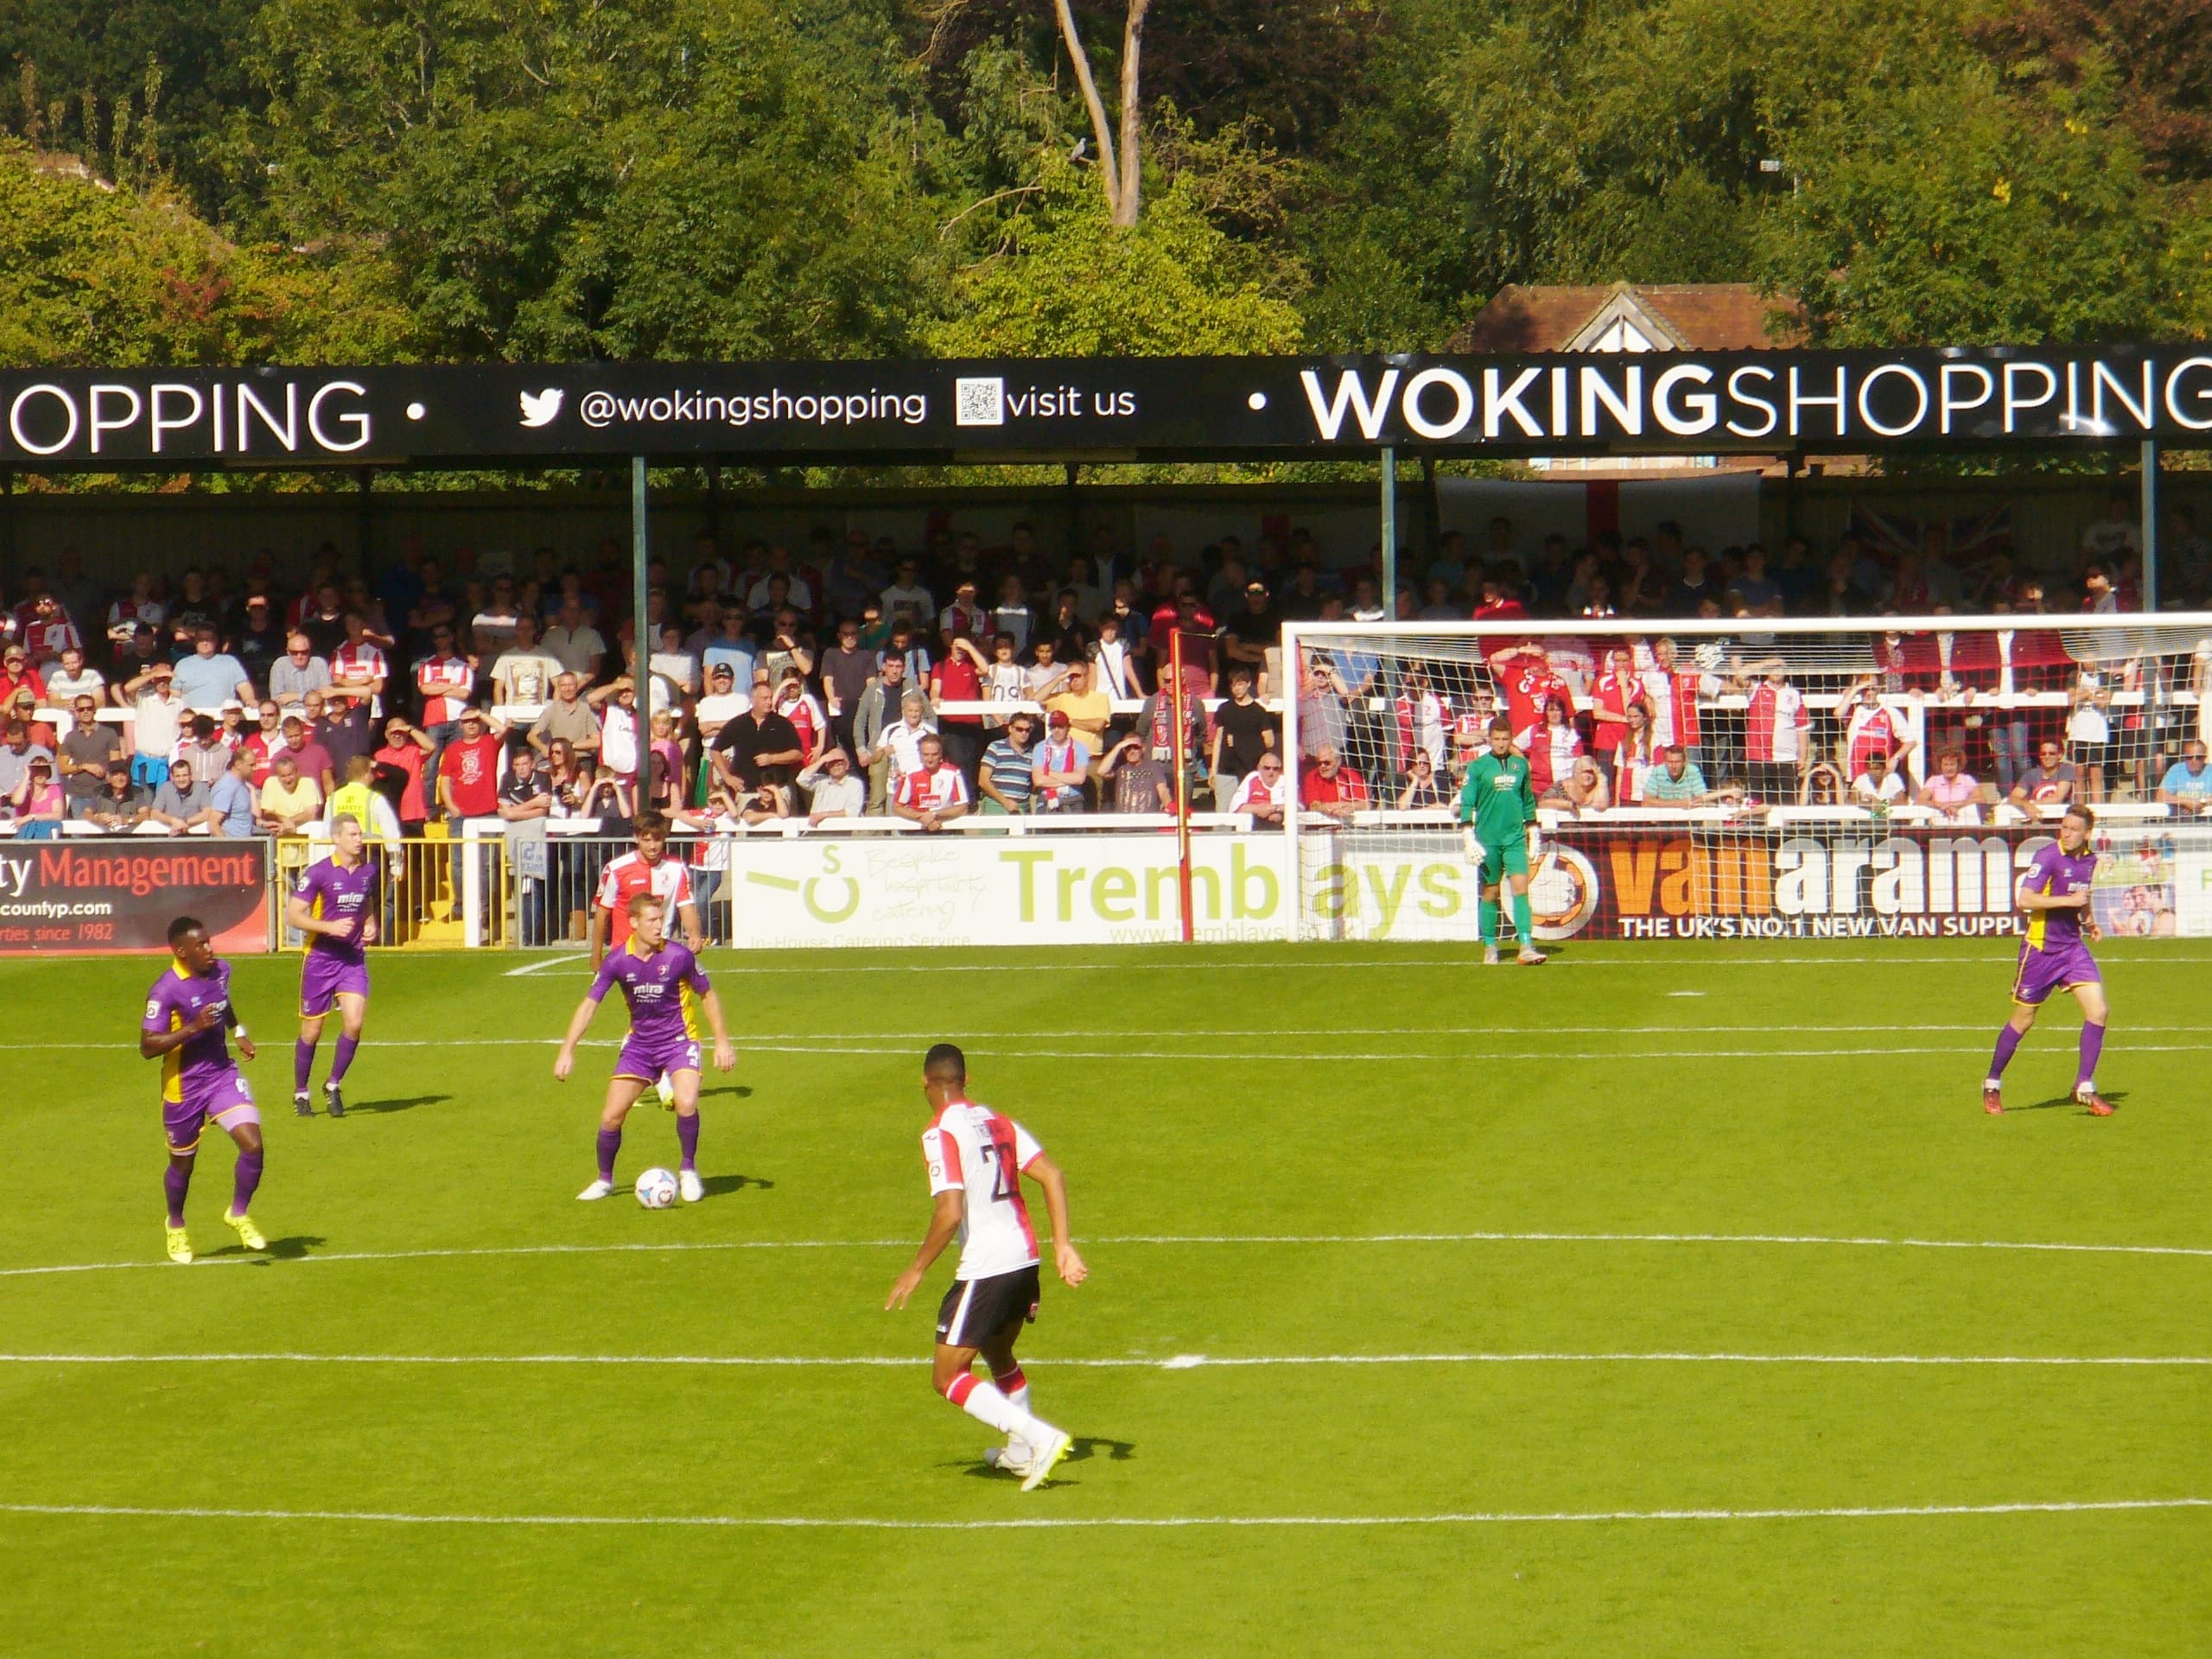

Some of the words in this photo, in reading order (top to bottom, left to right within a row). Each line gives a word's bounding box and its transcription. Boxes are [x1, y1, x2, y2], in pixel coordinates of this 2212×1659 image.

[10, 380, 372, 454] OPPING
[580, 388, 926, 429] @wokingshopping
[1006, 385, 1081, 417] visit
[1095, 389, 1136, 416] us
[40, 848, 256, 896] Management
[999, 842, 1463, 938] Trembays
[35, 925, 72, 941] since
[79, 922, 113, 941] 1982
[1618, 917, 1670, 938] THE
[1677, 917, 1734, 938] UK'S
[1742, 917, 1804, 938] NO.1
[1813, 917, 1867, 938] NEW
[1878, 917, 1936, 938] VAN
[1943, 916, 2031, 937] SUPPL
[632, 982, 664, 995] mira
